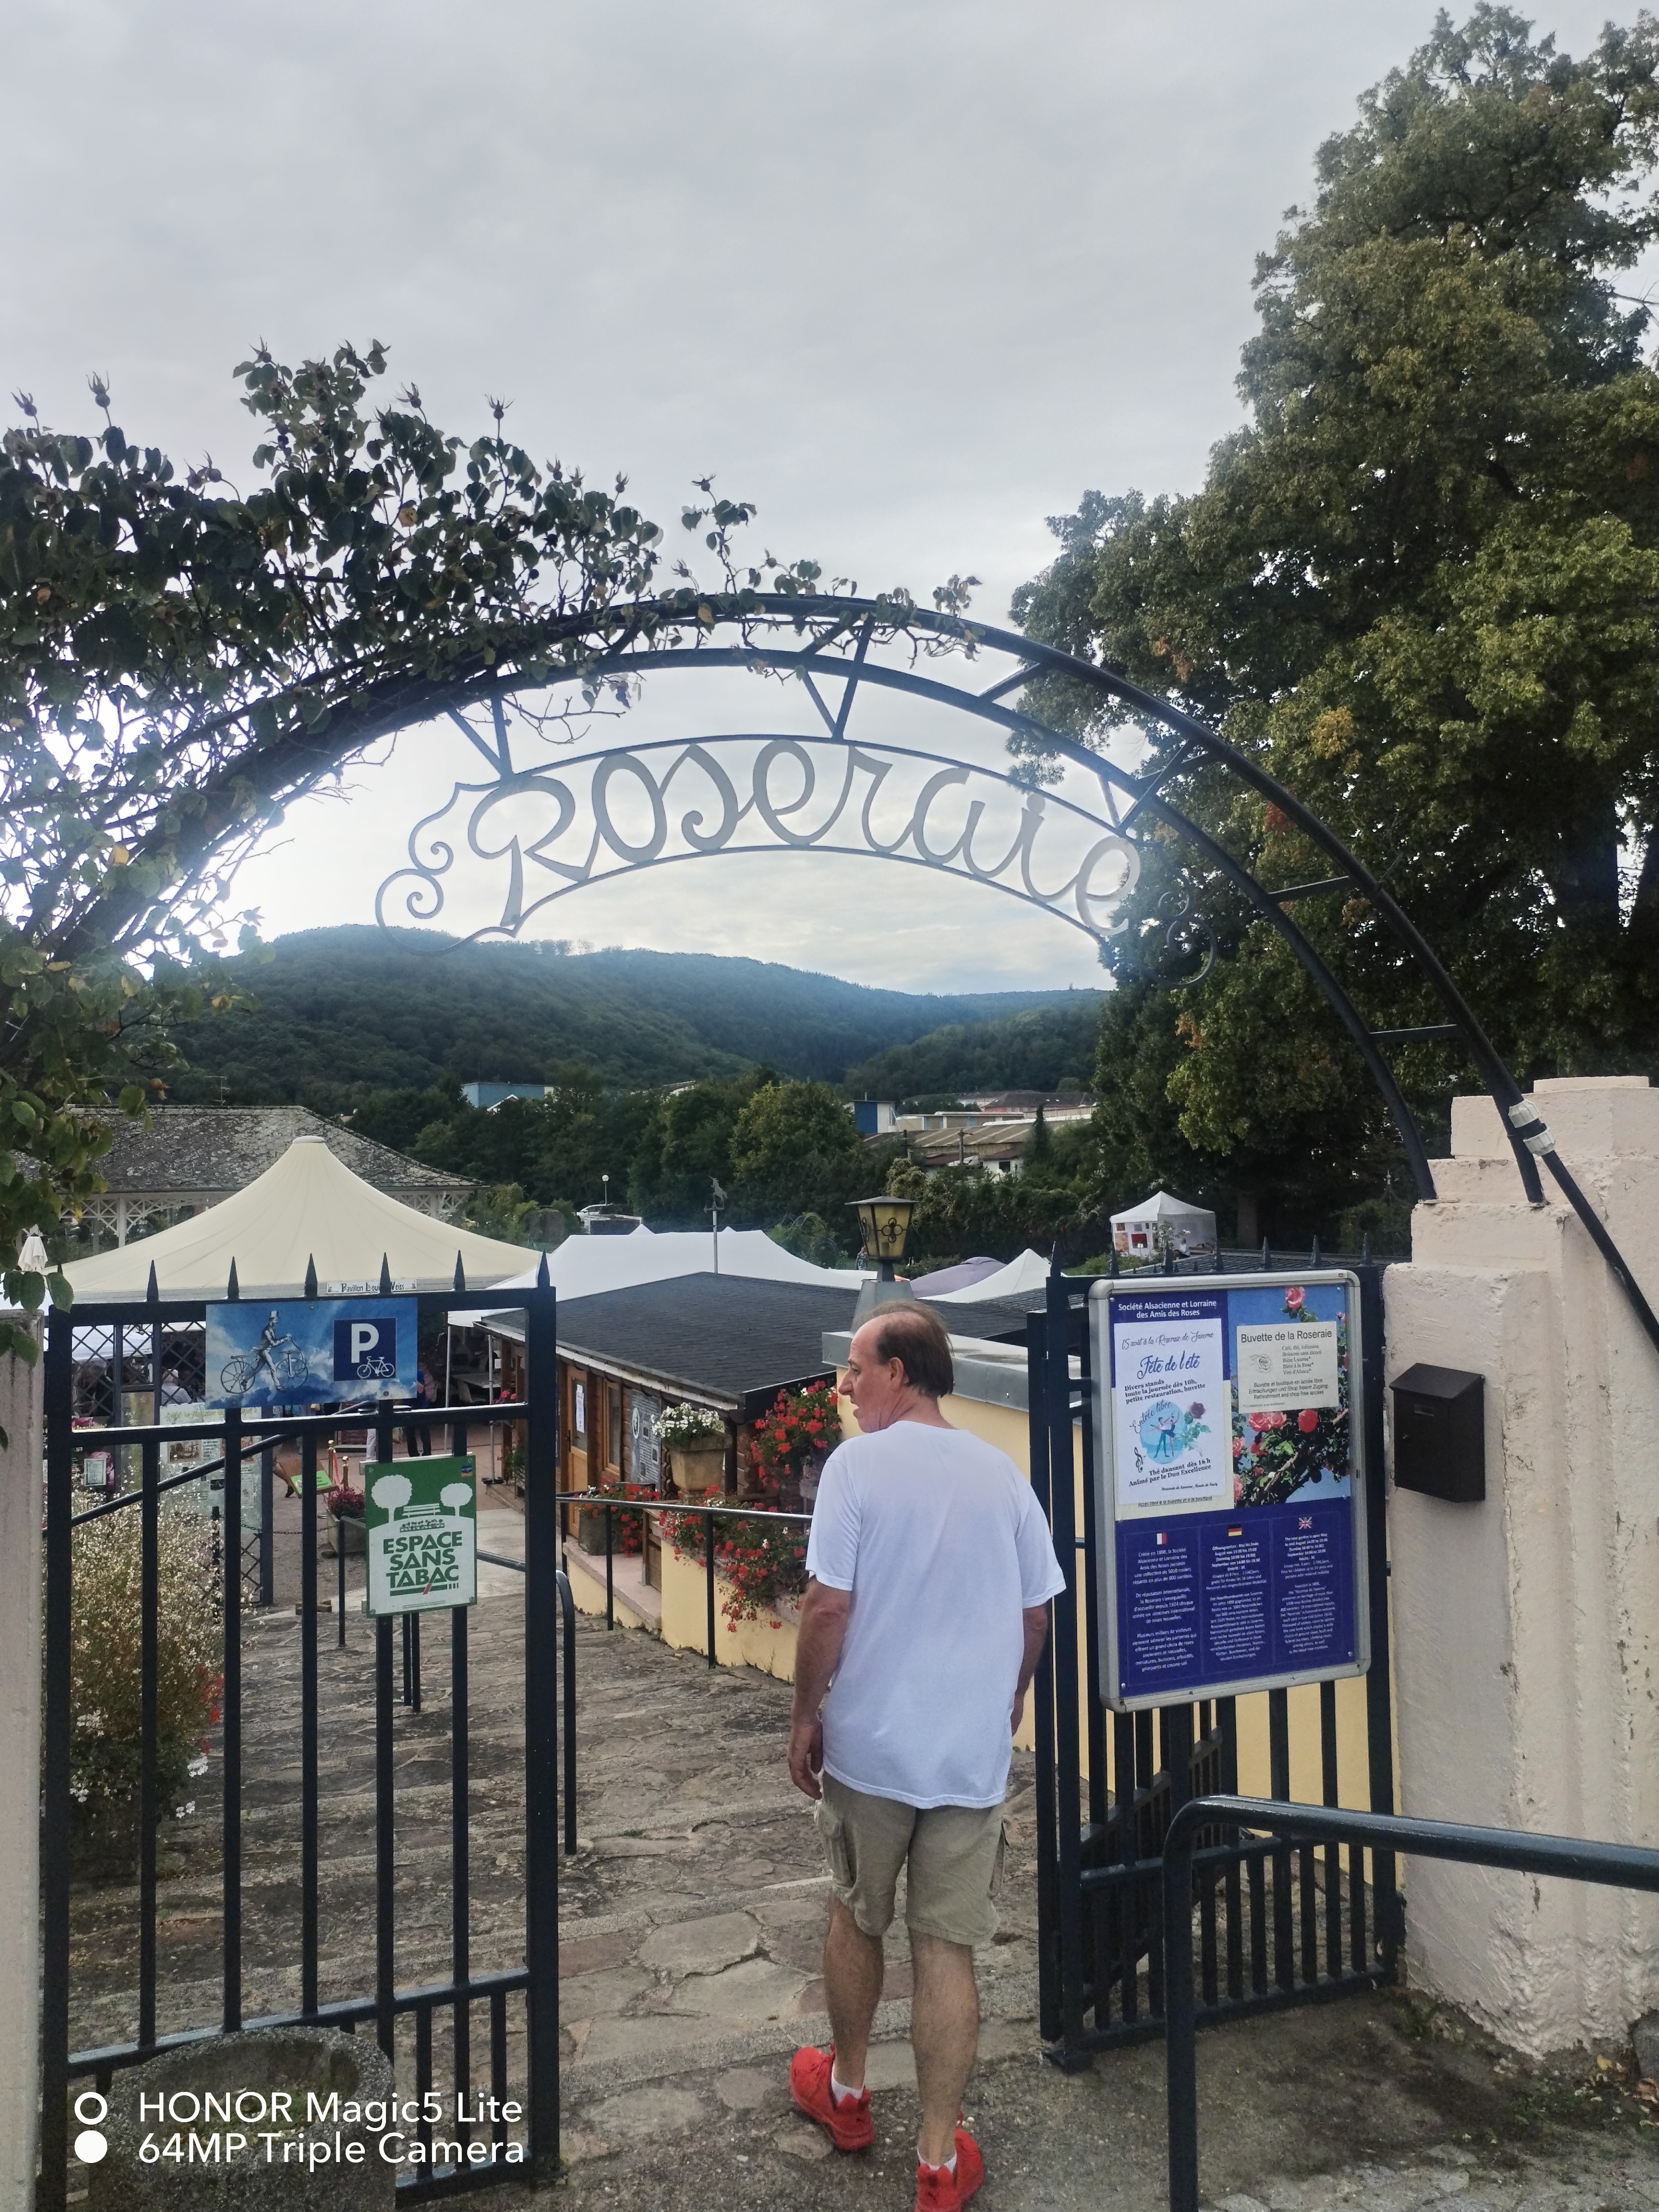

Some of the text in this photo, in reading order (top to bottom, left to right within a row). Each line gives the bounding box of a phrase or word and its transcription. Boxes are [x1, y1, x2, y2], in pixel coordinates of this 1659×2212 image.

[468, 739, 1141, 937] Roseraie
[341, 1283, 363, 1292] Pavillon
[1118, 1302, 1142, 1310] Société
[1144, 1301, 1180, 1310] Alsacienne
[351, 1323, 379, 1363] P
[1149, 1336, 1154, 1345] la
[1241, 1329, 1332, 1343] Buvette de la Roseraie
[1137, 1355, 1164, 1380] Fête
[1165, 1355, 1177, 1371] de
[1126, 1383, 1205, 1405] petite restauration, buvette
[1148, 1383, 1172, 1394] journée
[1130, 1409, 1154, 1434] Entrée
[1129, 1478, 1148, 1486] Animé
[1181, 1465, 1212, 1475] Excellence
[1161, 1465, 1185, 1473] dansant
[384, 1531, 462, 1554] ESPACE
[389, 1548, 456, 1571] SANS
[386, 1565, 458, 1589] TABAC
